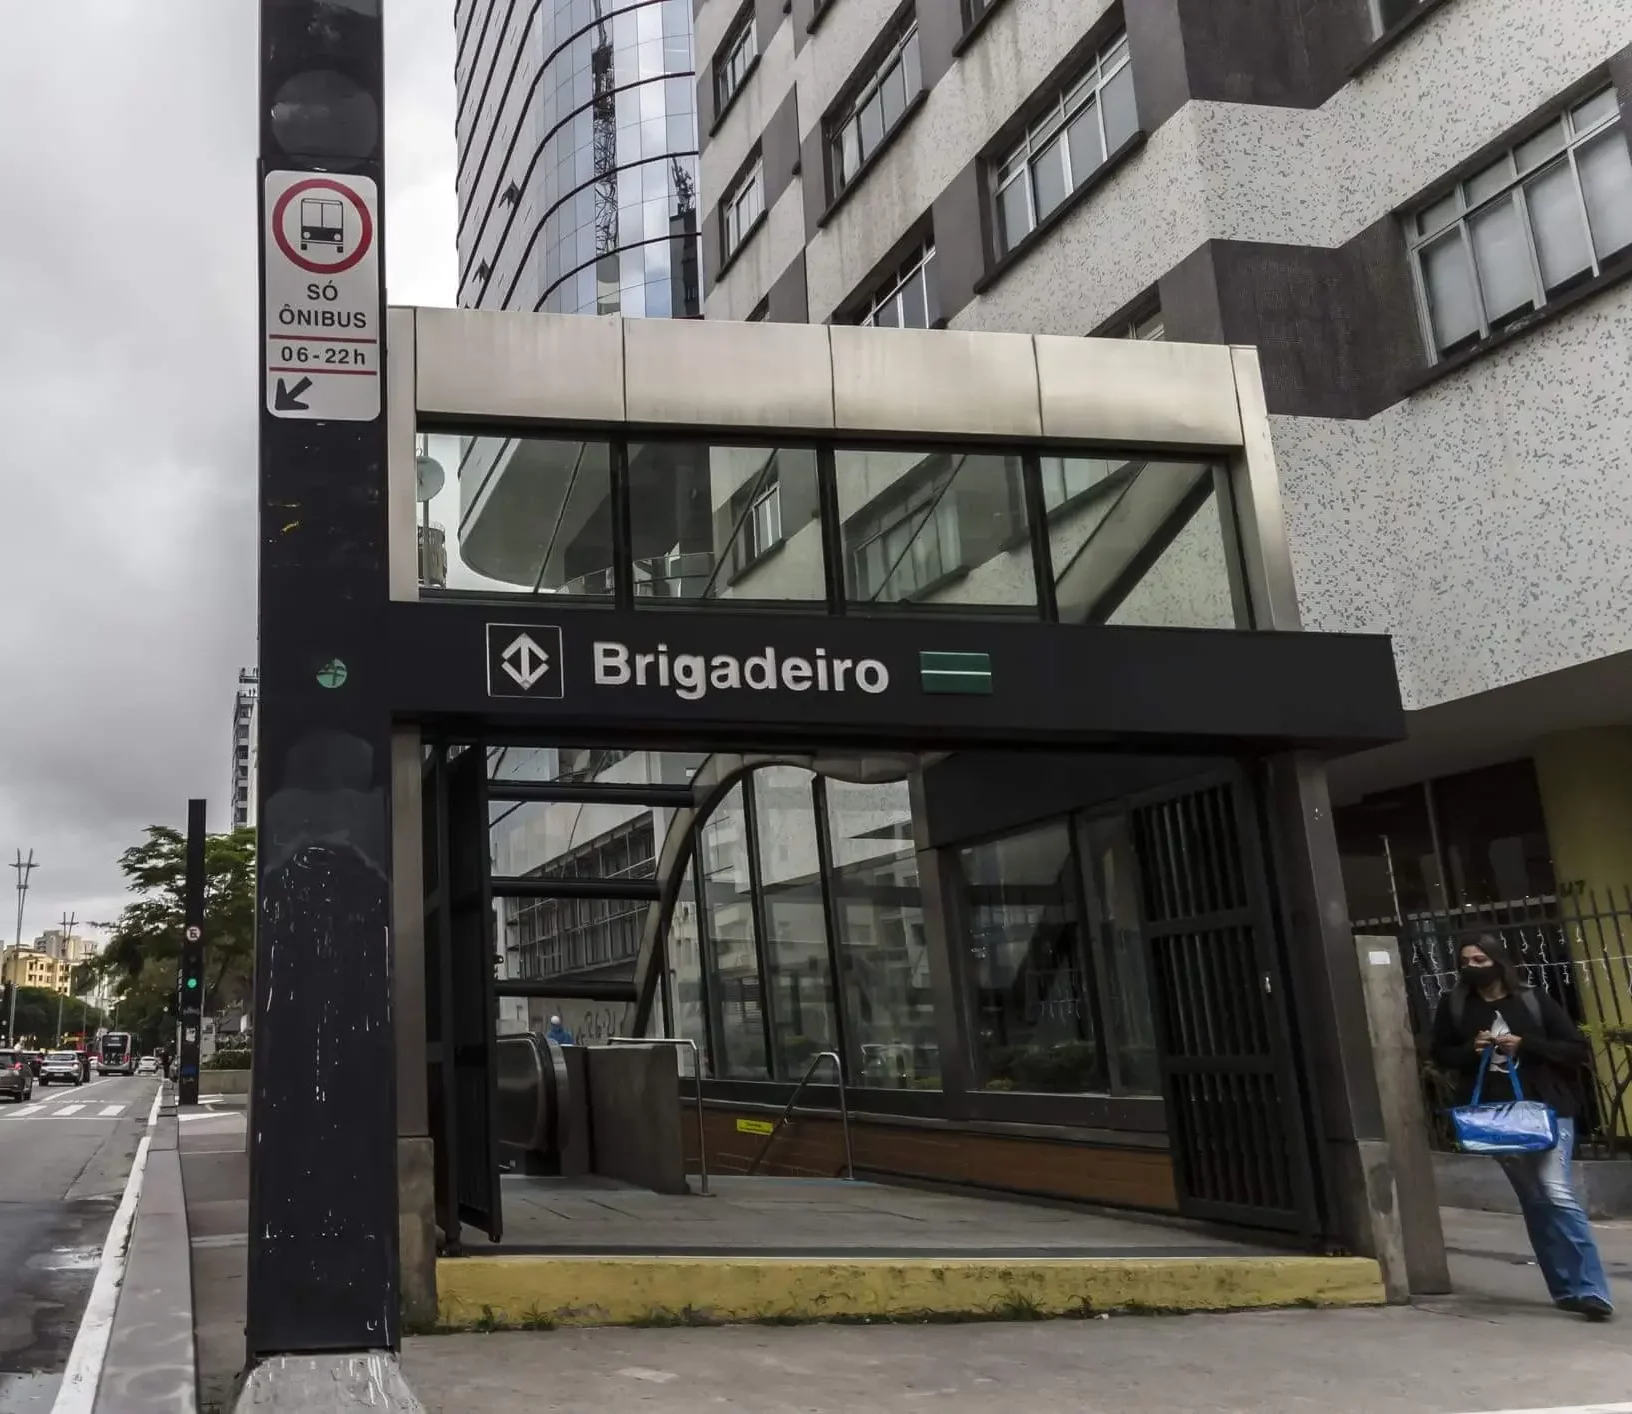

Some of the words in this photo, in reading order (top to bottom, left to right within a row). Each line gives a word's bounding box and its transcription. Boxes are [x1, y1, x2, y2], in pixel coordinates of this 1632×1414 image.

[306, 280, 339, 302] SÓ
[278, 303, 367, 329] ÔNIBUS
[592, 640, 890, 700] Brigadeiro
